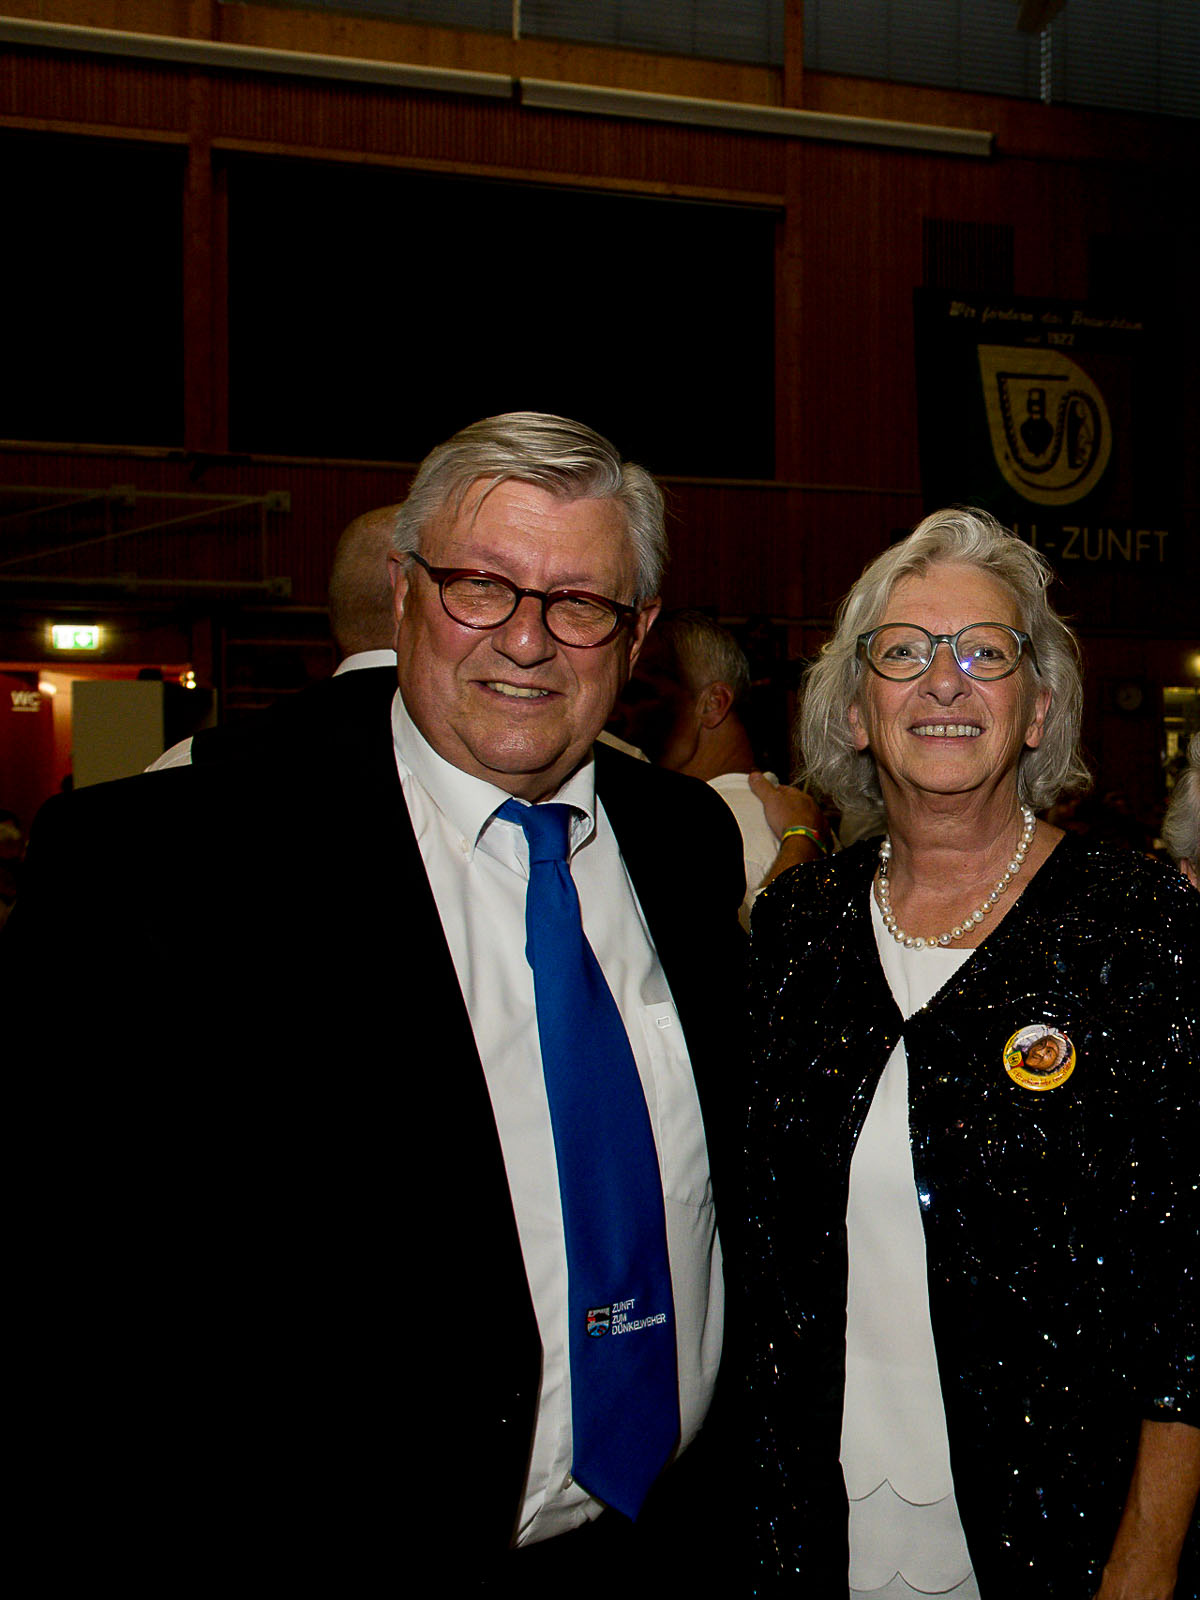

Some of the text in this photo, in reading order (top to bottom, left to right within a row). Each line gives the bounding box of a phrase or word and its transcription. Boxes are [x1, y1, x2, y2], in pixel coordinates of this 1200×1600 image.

[11, 690, 40, 706] WC
[612, 1298, 636, 1313] ZUNFT
[612, 1313, 627, 1324] ZUM
